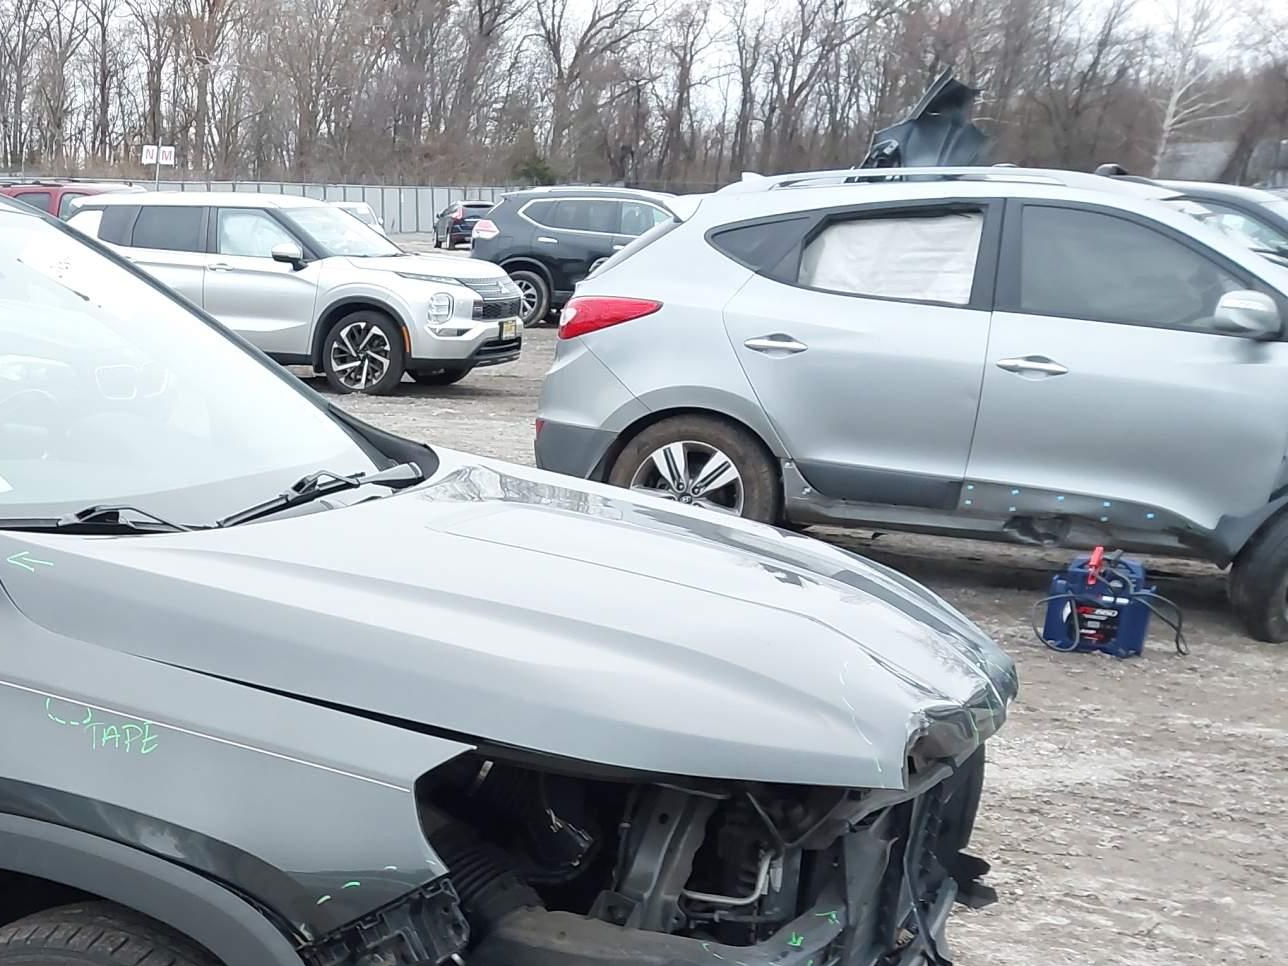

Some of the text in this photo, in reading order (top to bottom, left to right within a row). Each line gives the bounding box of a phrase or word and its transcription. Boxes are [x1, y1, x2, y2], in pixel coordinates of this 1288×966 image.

[145, 149, 155, 160] N
[161, 150, 173, 161] M
[84, 720, 159, 754] TAPE
